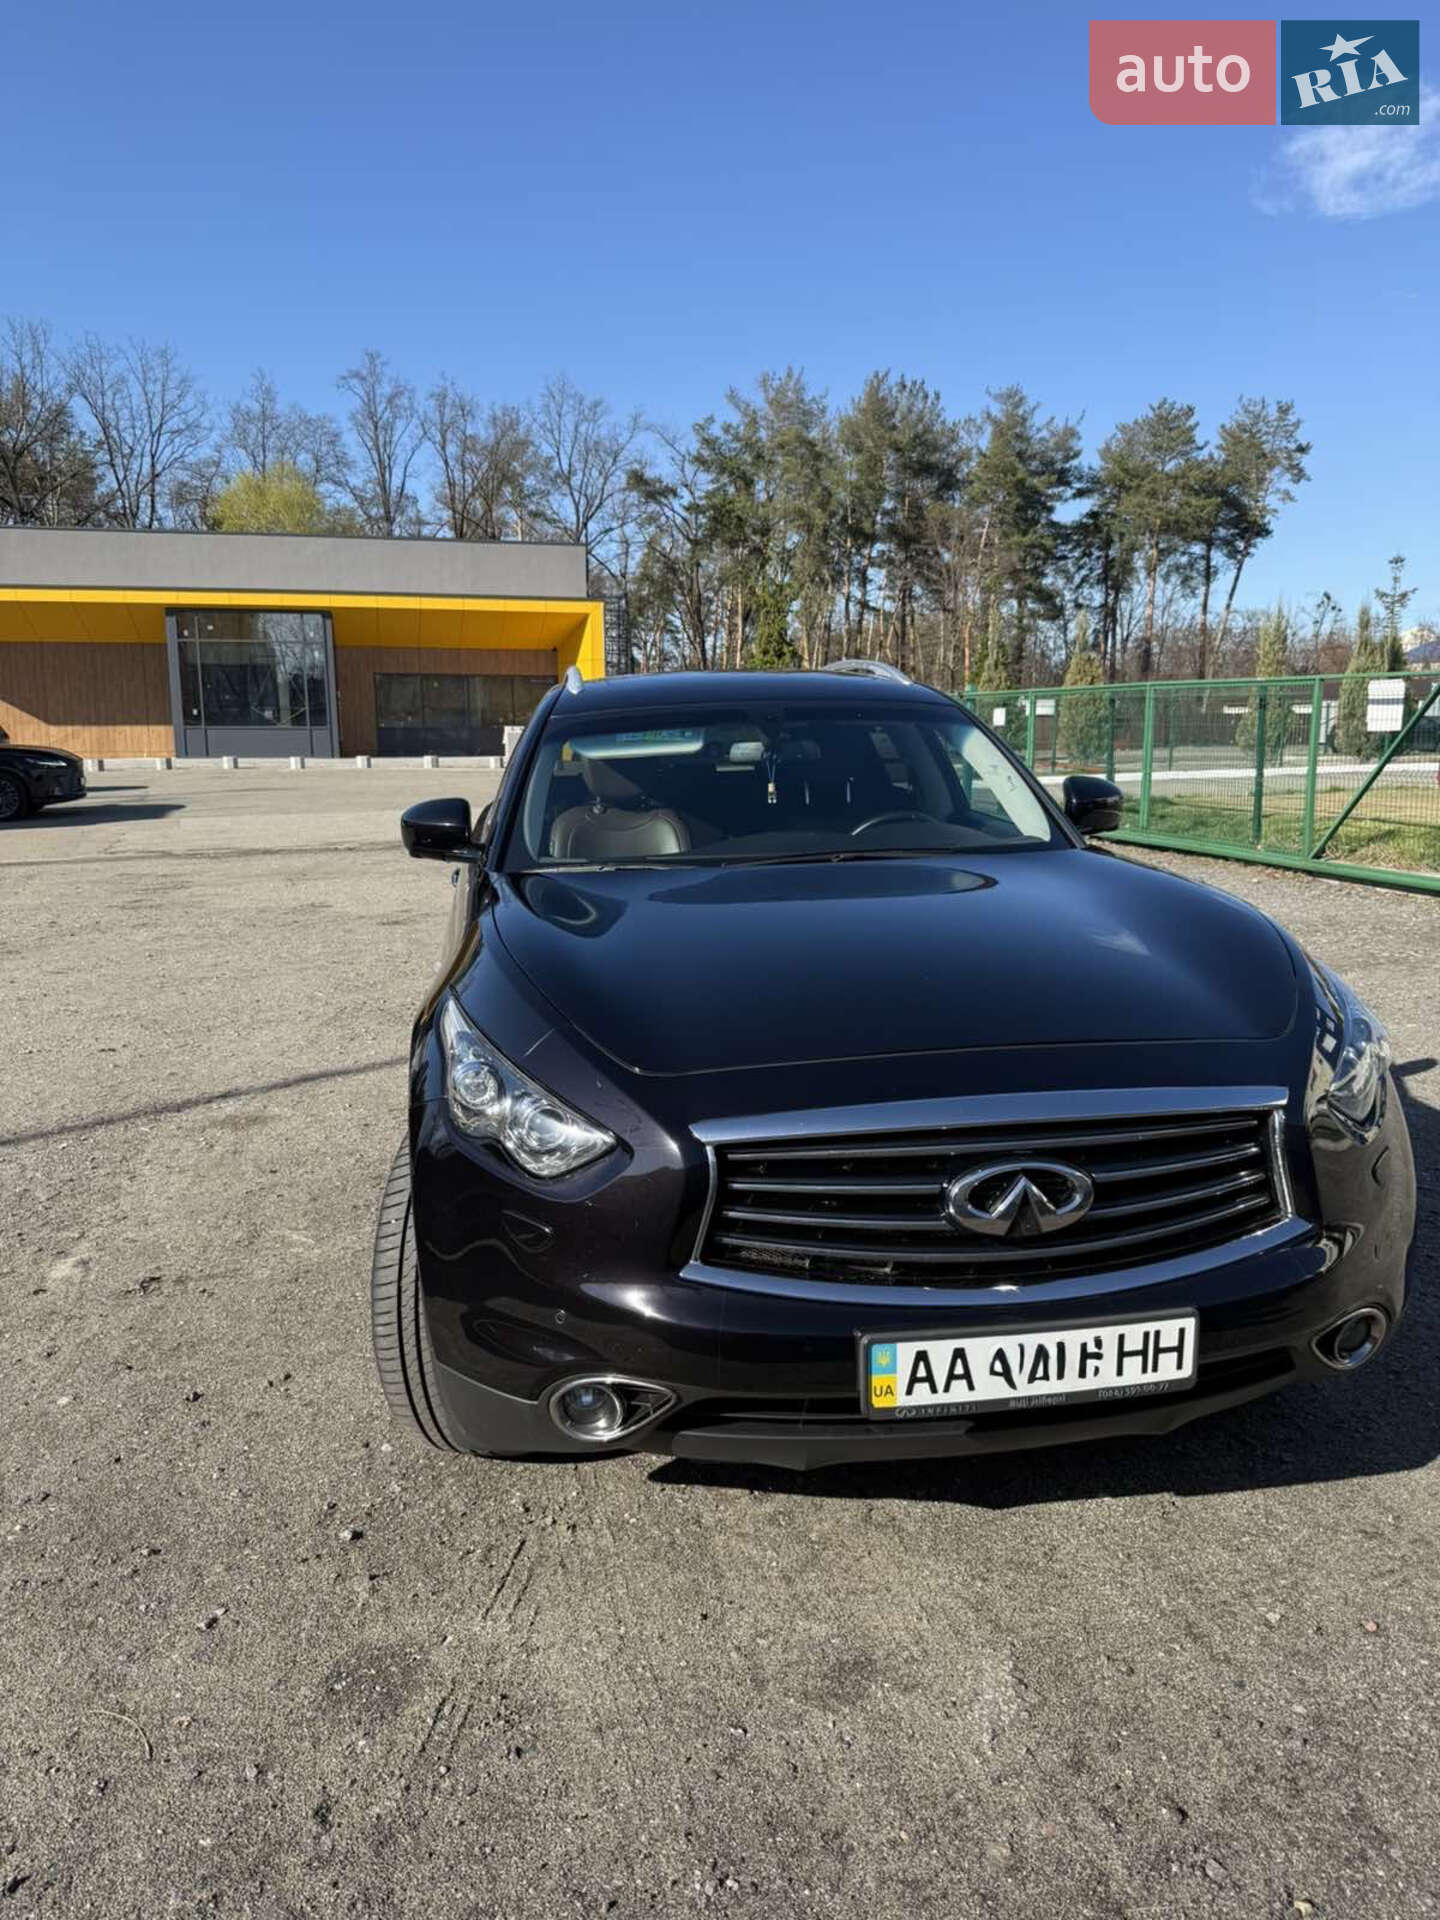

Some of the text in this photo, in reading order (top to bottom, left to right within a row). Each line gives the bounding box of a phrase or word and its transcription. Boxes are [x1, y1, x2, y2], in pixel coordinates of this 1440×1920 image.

[904, 1346, 976, 1397] AA
[1115, 1326, 1187, 1378] HH
[873, 1383, 896, 1399] UA
